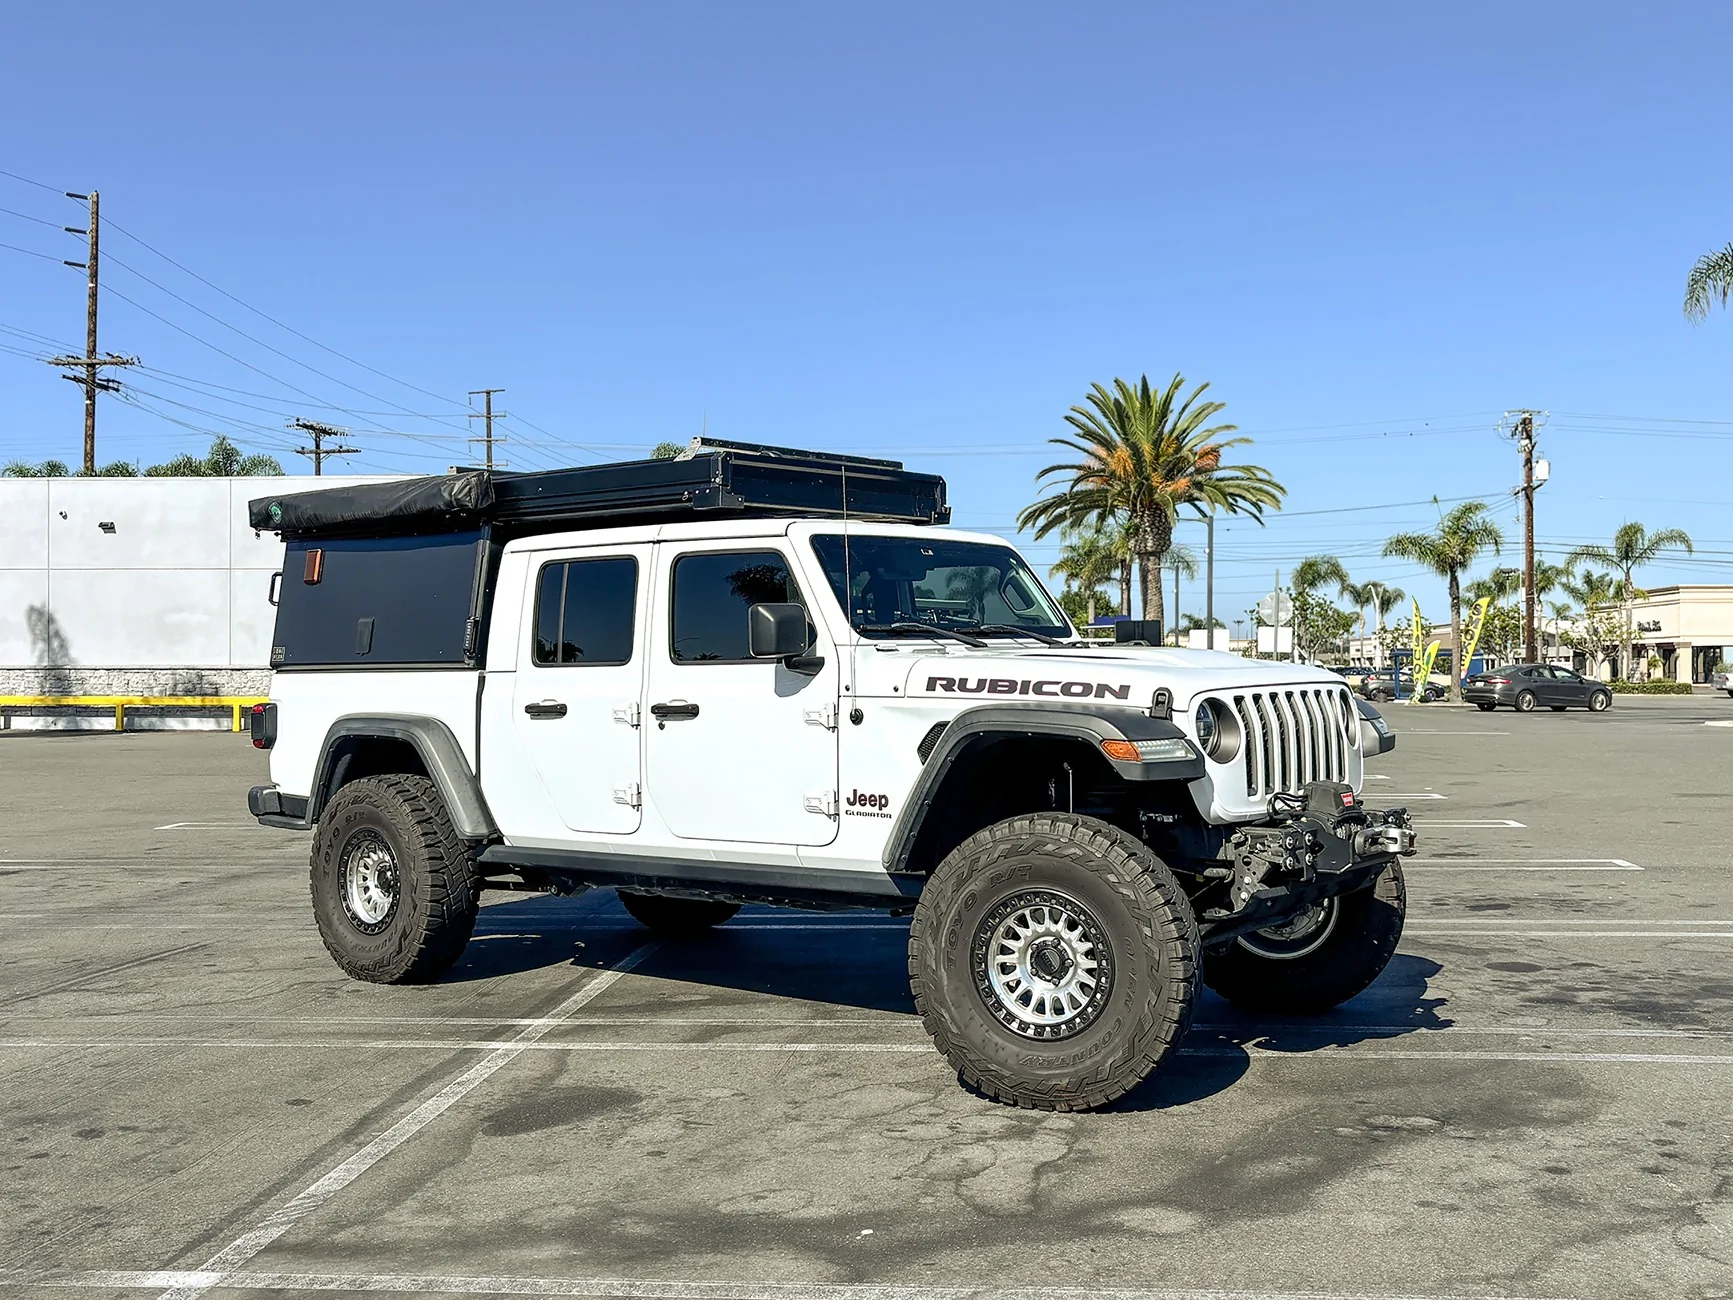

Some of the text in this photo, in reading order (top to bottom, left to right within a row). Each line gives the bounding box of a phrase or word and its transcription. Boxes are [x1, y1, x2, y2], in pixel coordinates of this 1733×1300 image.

[925, 676, 1131, 700] RUBICON
[845, 809, 892, 819] GLADIATOR
[846, 788, 889, 811] Jeep
[322, 826, 341, 879] TOYO
[946, 864, 1033, 970] TOYO R/T
[1018, 936, 1138, 1070] OPEN COUNTRY
